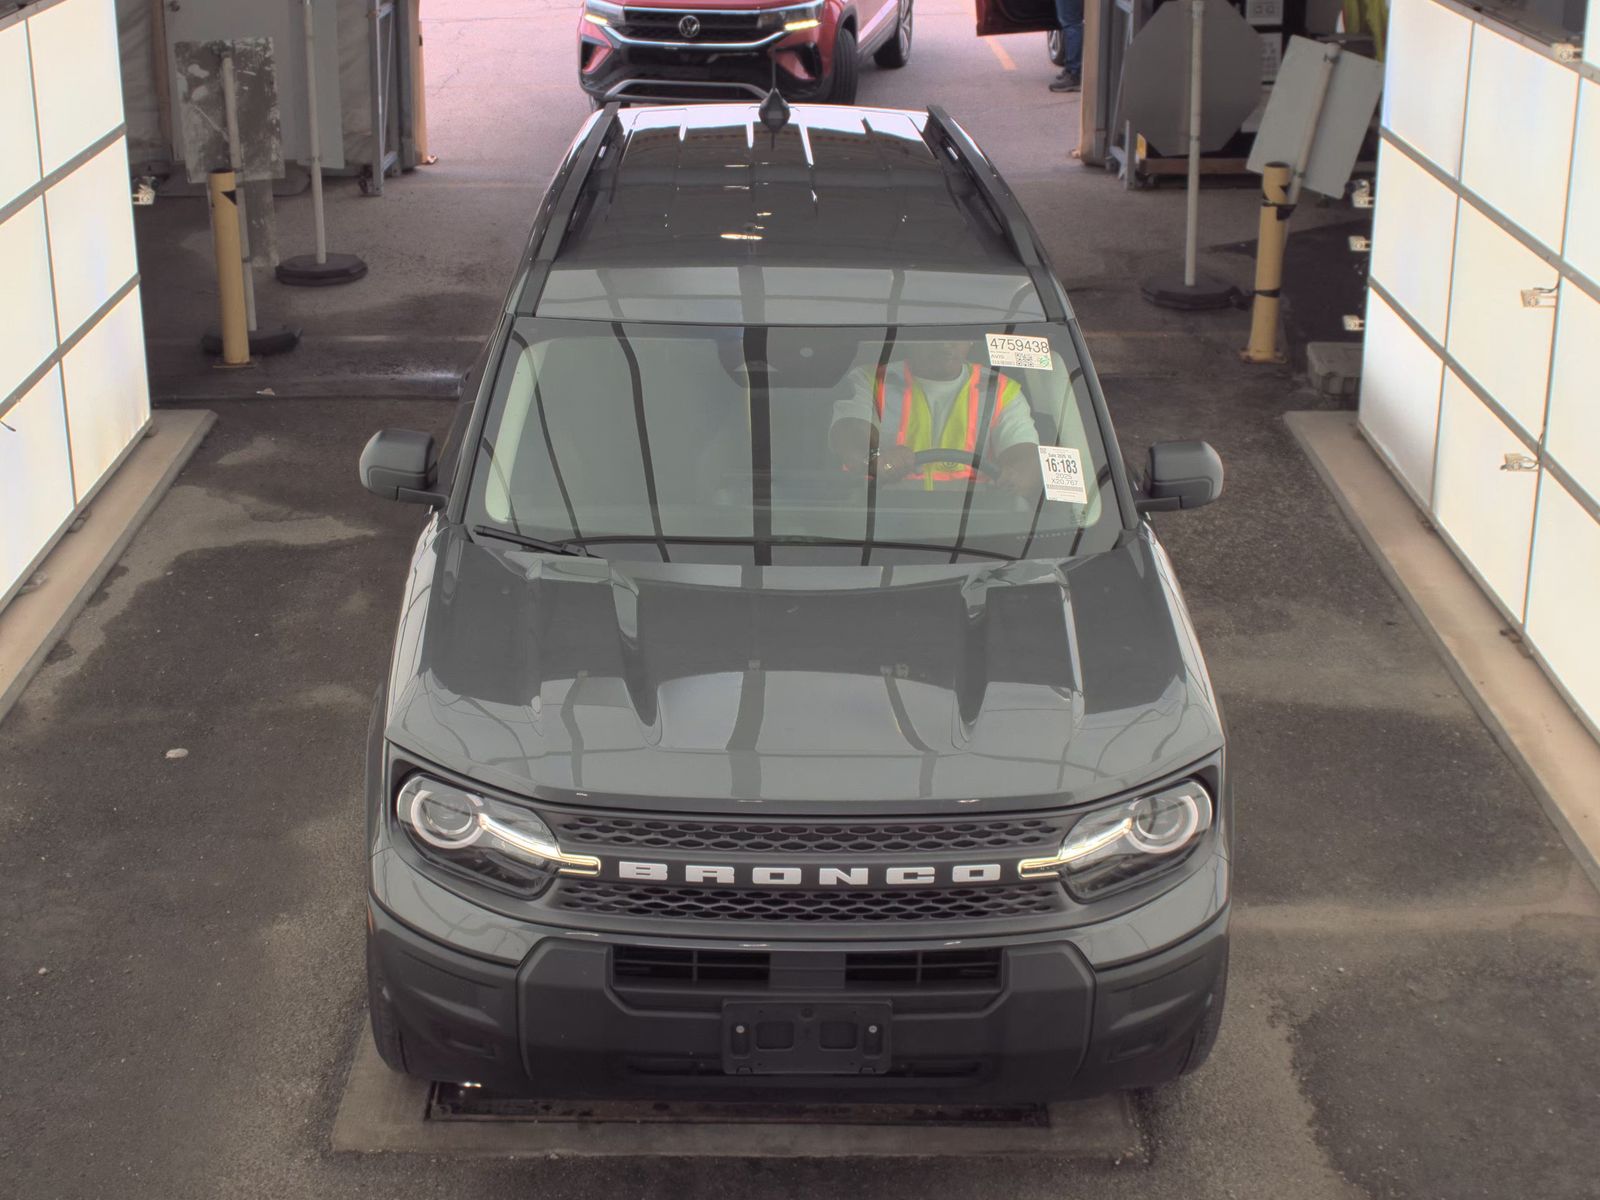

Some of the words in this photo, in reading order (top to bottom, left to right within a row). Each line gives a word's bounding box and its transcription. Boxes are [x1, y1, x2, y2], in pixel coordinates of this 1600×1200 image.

[990, 338, 1049, 354] 4759438
[1045, 458, 1078, 474] 16:183
[618, 860, 1001, 885] BRONCO
